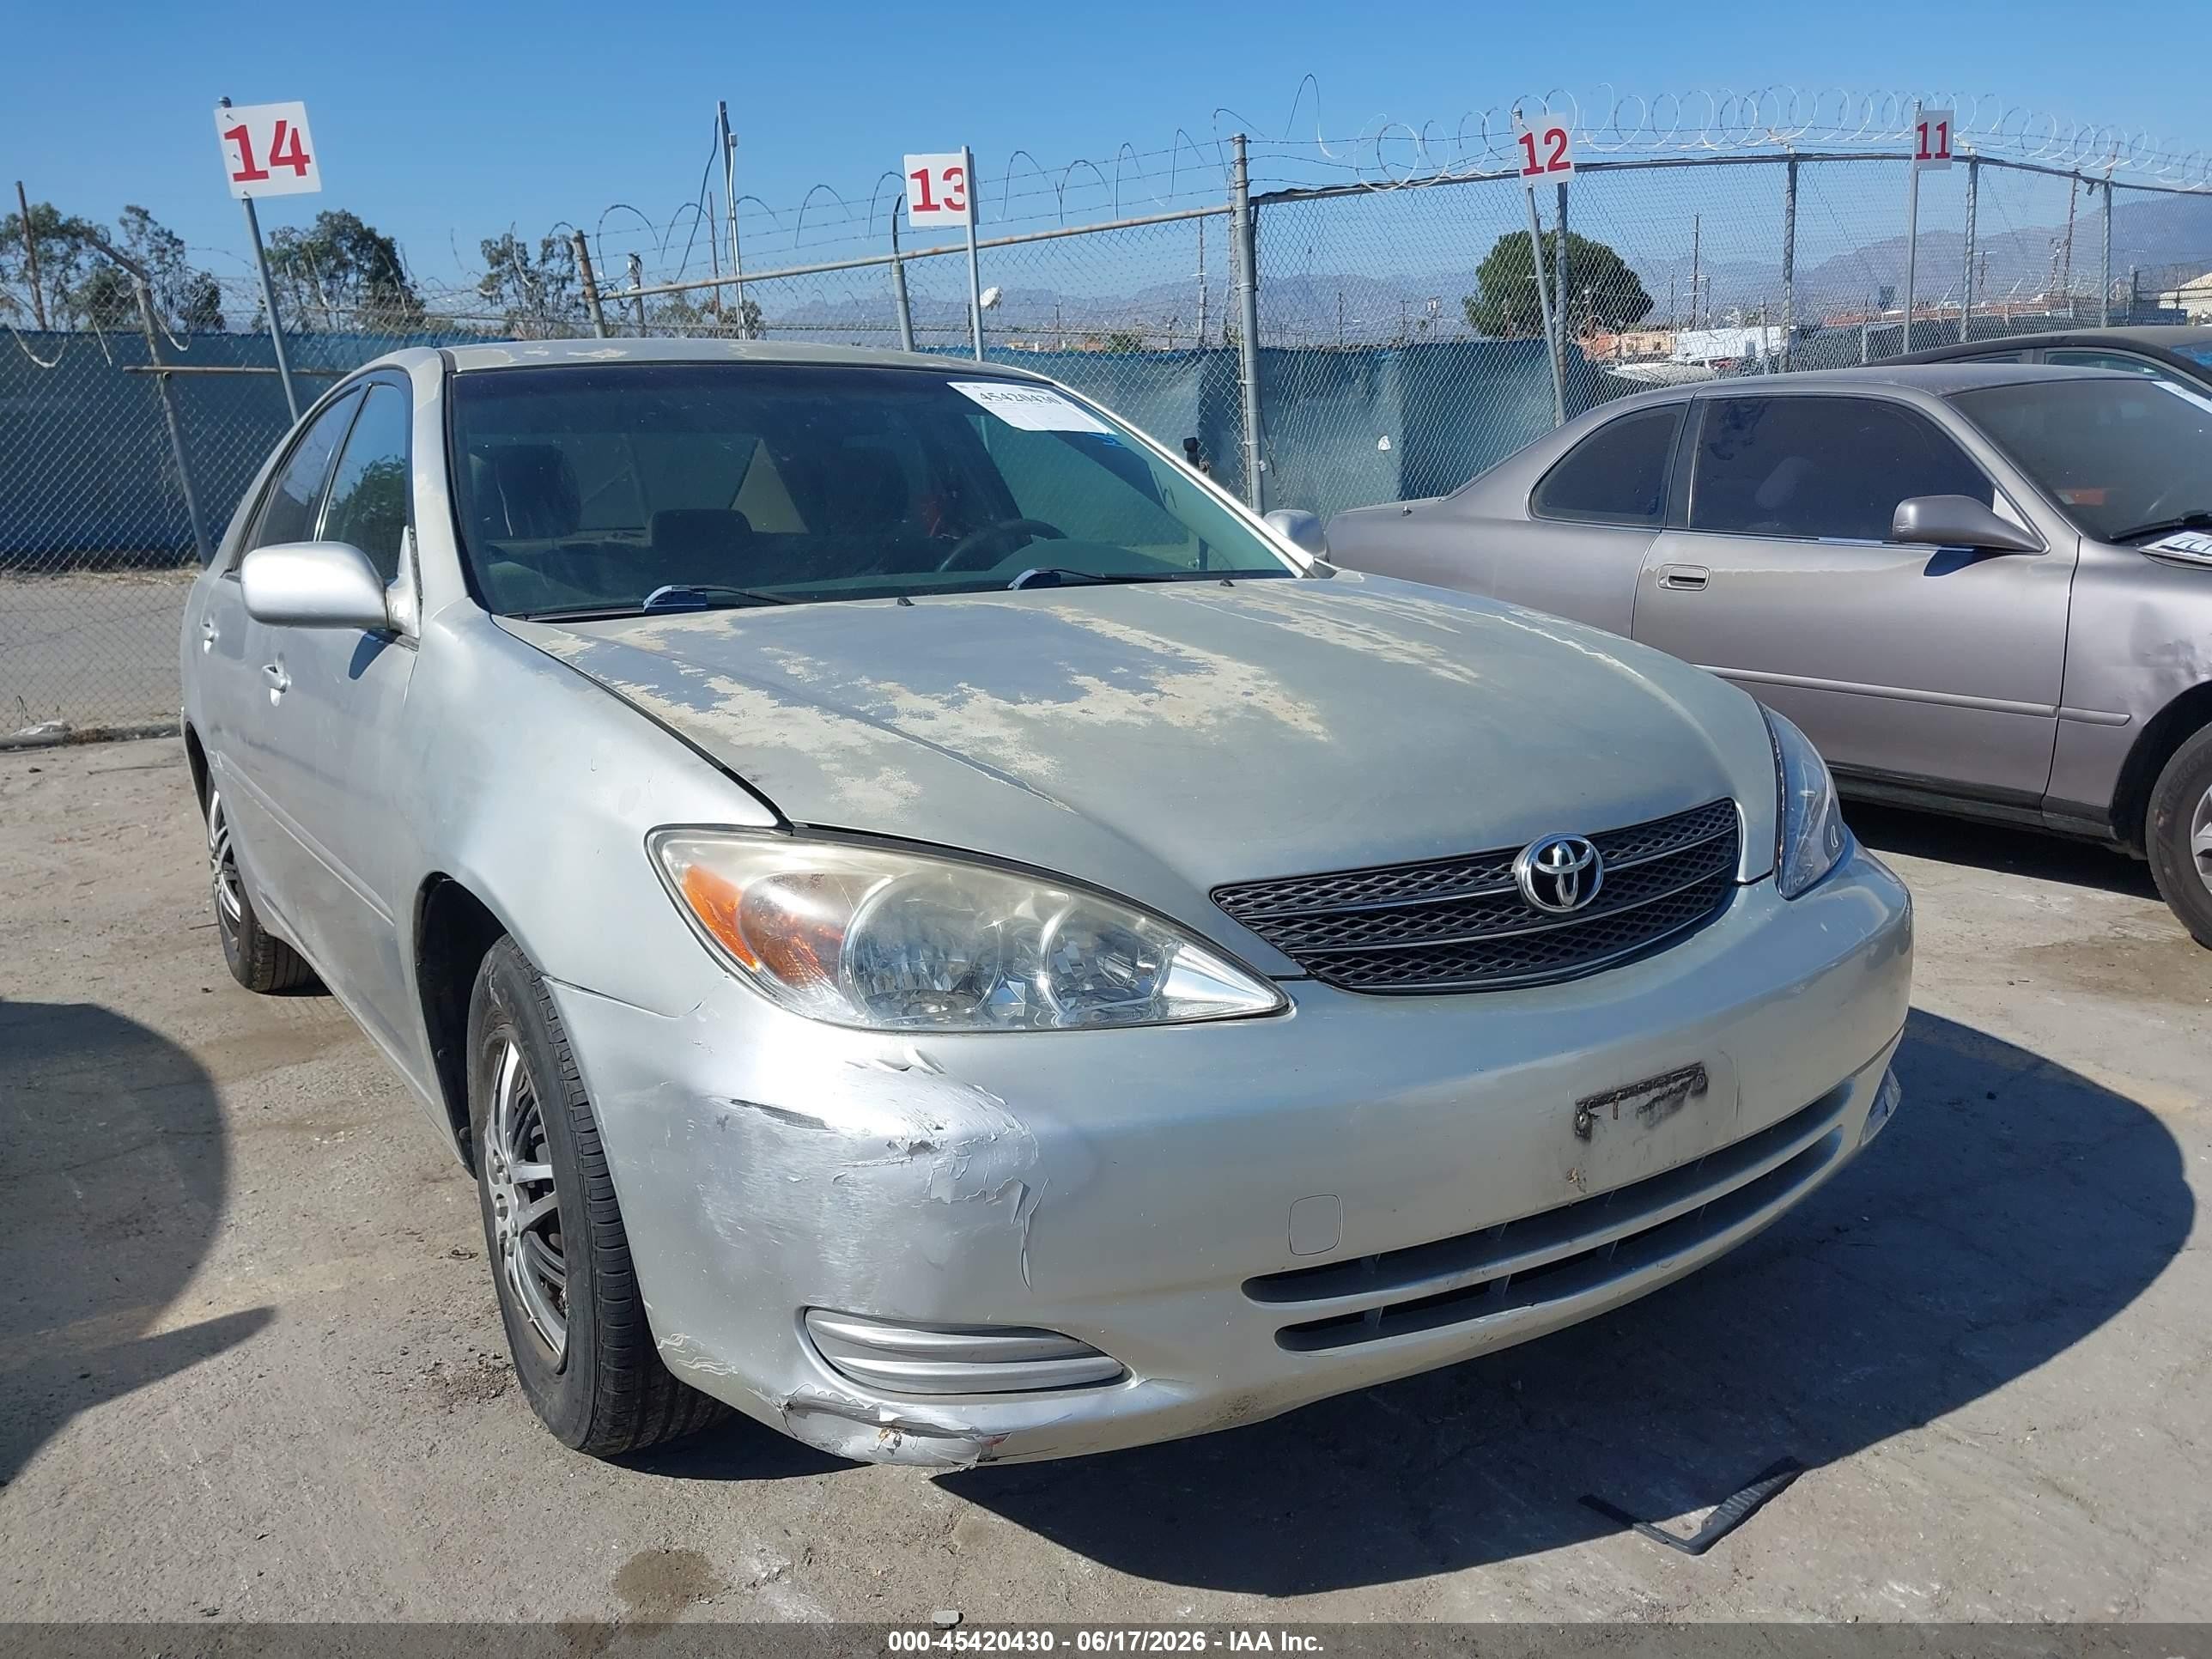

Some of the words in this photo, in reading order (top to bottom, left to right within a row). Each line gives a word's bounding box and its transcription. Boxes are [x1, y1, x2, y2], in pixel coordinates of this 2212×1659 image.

[224, 120, 311, 182] 14
[1518, 128, 1571, 176] 12
[1916, 121, 1950, 160] 11
[910, 167, 965, 212] 13
[980, 392, 1062, 405] 45420430
